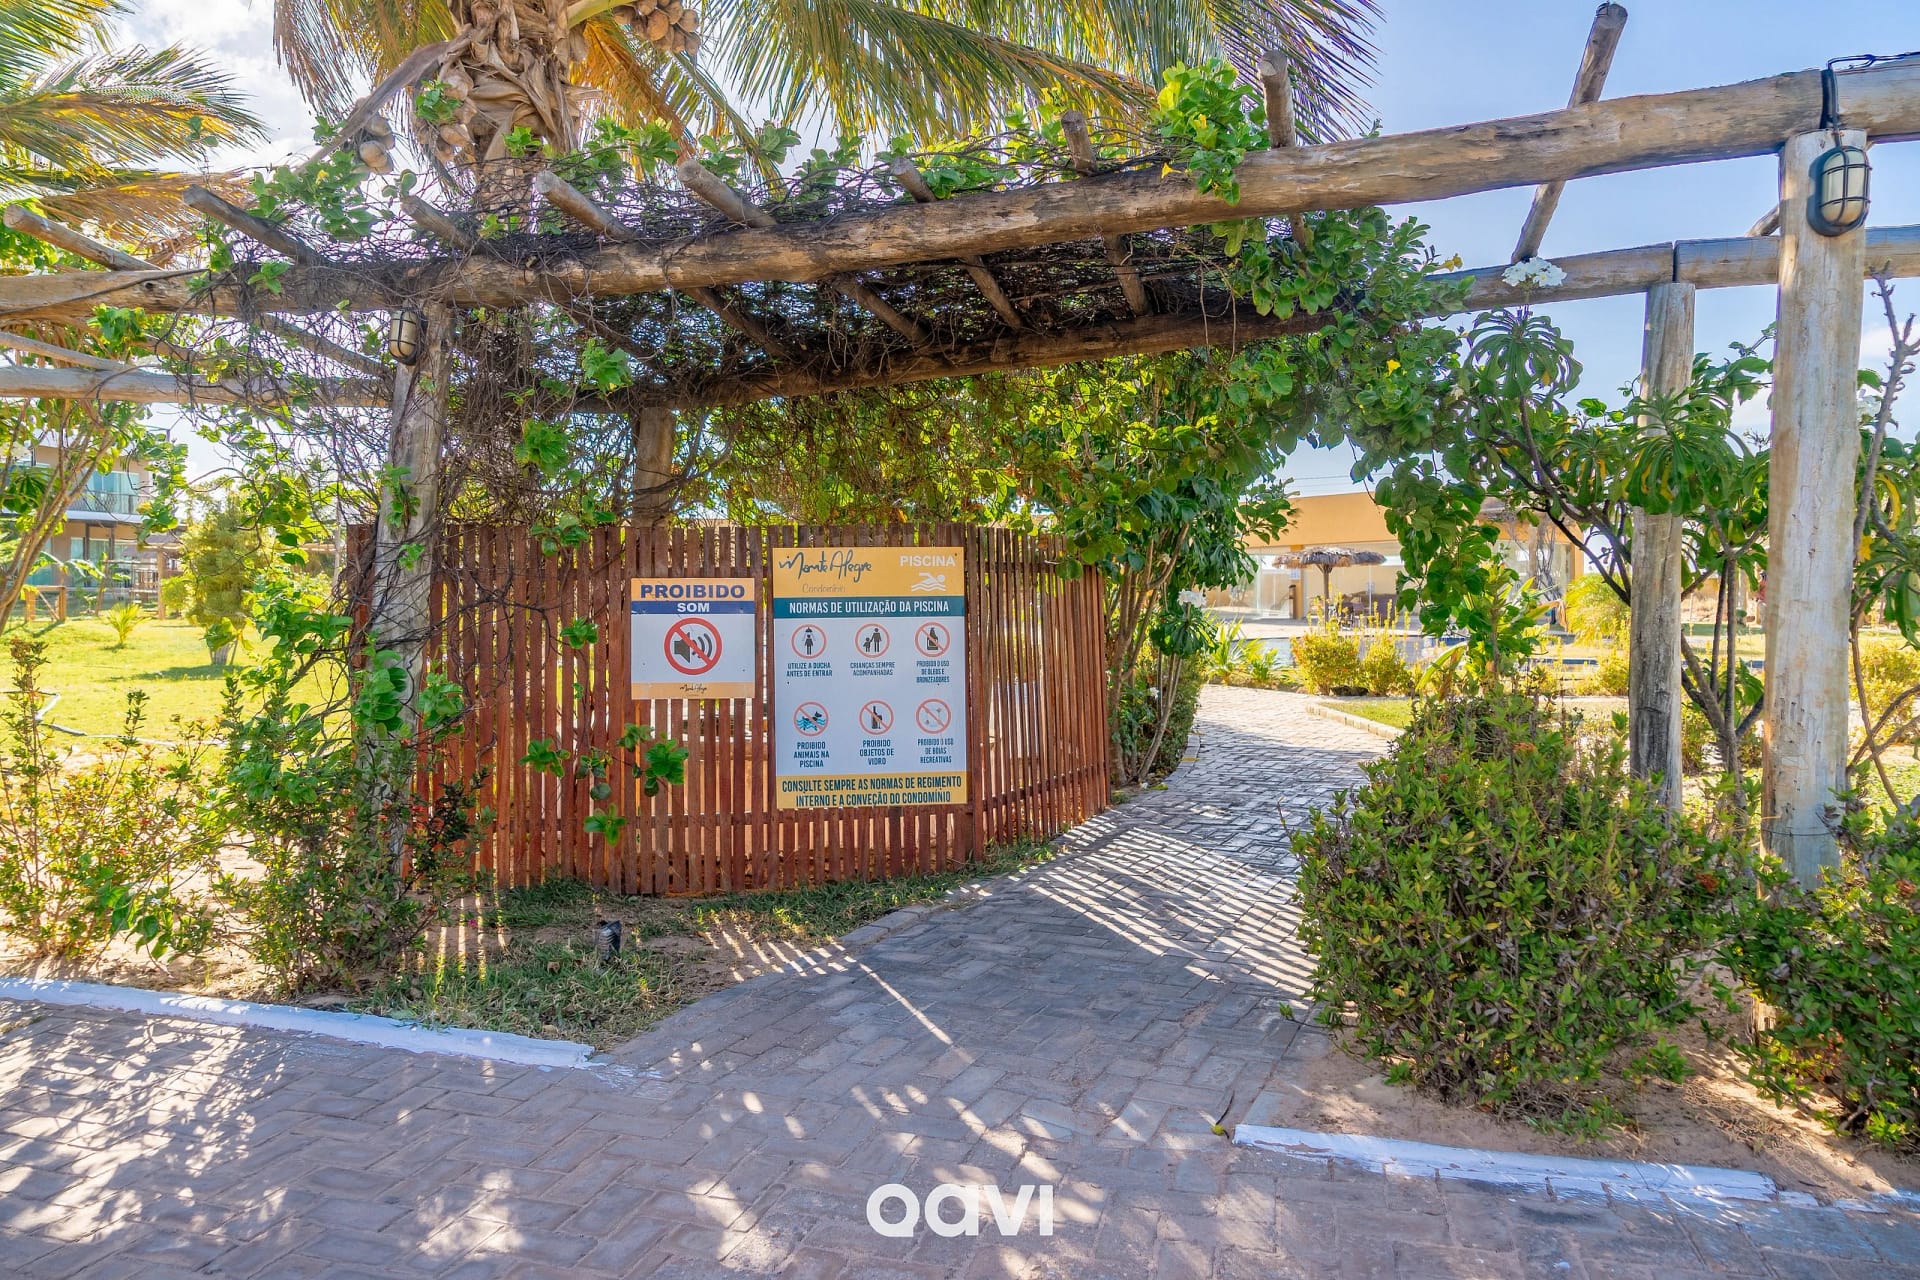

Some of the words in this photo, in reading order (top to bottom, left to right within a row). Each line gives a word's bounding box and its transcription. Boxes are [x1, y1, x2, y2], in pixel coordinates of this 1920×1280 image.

[828, 549, 872, 583] Alegre
[900, 555, 956, 567] PISCINA
[640, 584, 745, 598] PROIBIDO
[677, 602, 710, 613] SOM
[789, 602, 829, 614] NORMAS
[830, 601, 842, 613] DE
[845, 600, 897, 615] UTILIZAÇÃO
[900, 601, 912, 612] DA
[913, 600, 950, 612] PISCINA
[875, 661, 895, 669] SEMPRE
[797, 741, 826, 749] PROIBIDO
[862, 739, 891, 747] PROIBIDO
[821, 750, 830, 758] NA
[859, 748, 885, 756] OBJETOS
[886, 748, 894, 756] DE
[919, 755, 952, 763] RECREATIVAS
[782, 780, 822, 793] CONSULTE
[824, 779, 856, 792] SEMPRE
[858, 778, 869, 790] AS
[870, 777, 903, 790] NORMAS
[905, 777, 915, 789] DE
[917, 776, 962, 789] REGIMENTO
[796, 794, 830, 807] INTERNO
[832, 794, 837, 806] E
[839, 794, 845, 806] A
[846, 792, 888, 807] CONVEÇÃO
[890, 792, 900, 804] DO
[902, 789, 951, 803] CONDOMÍNIO
